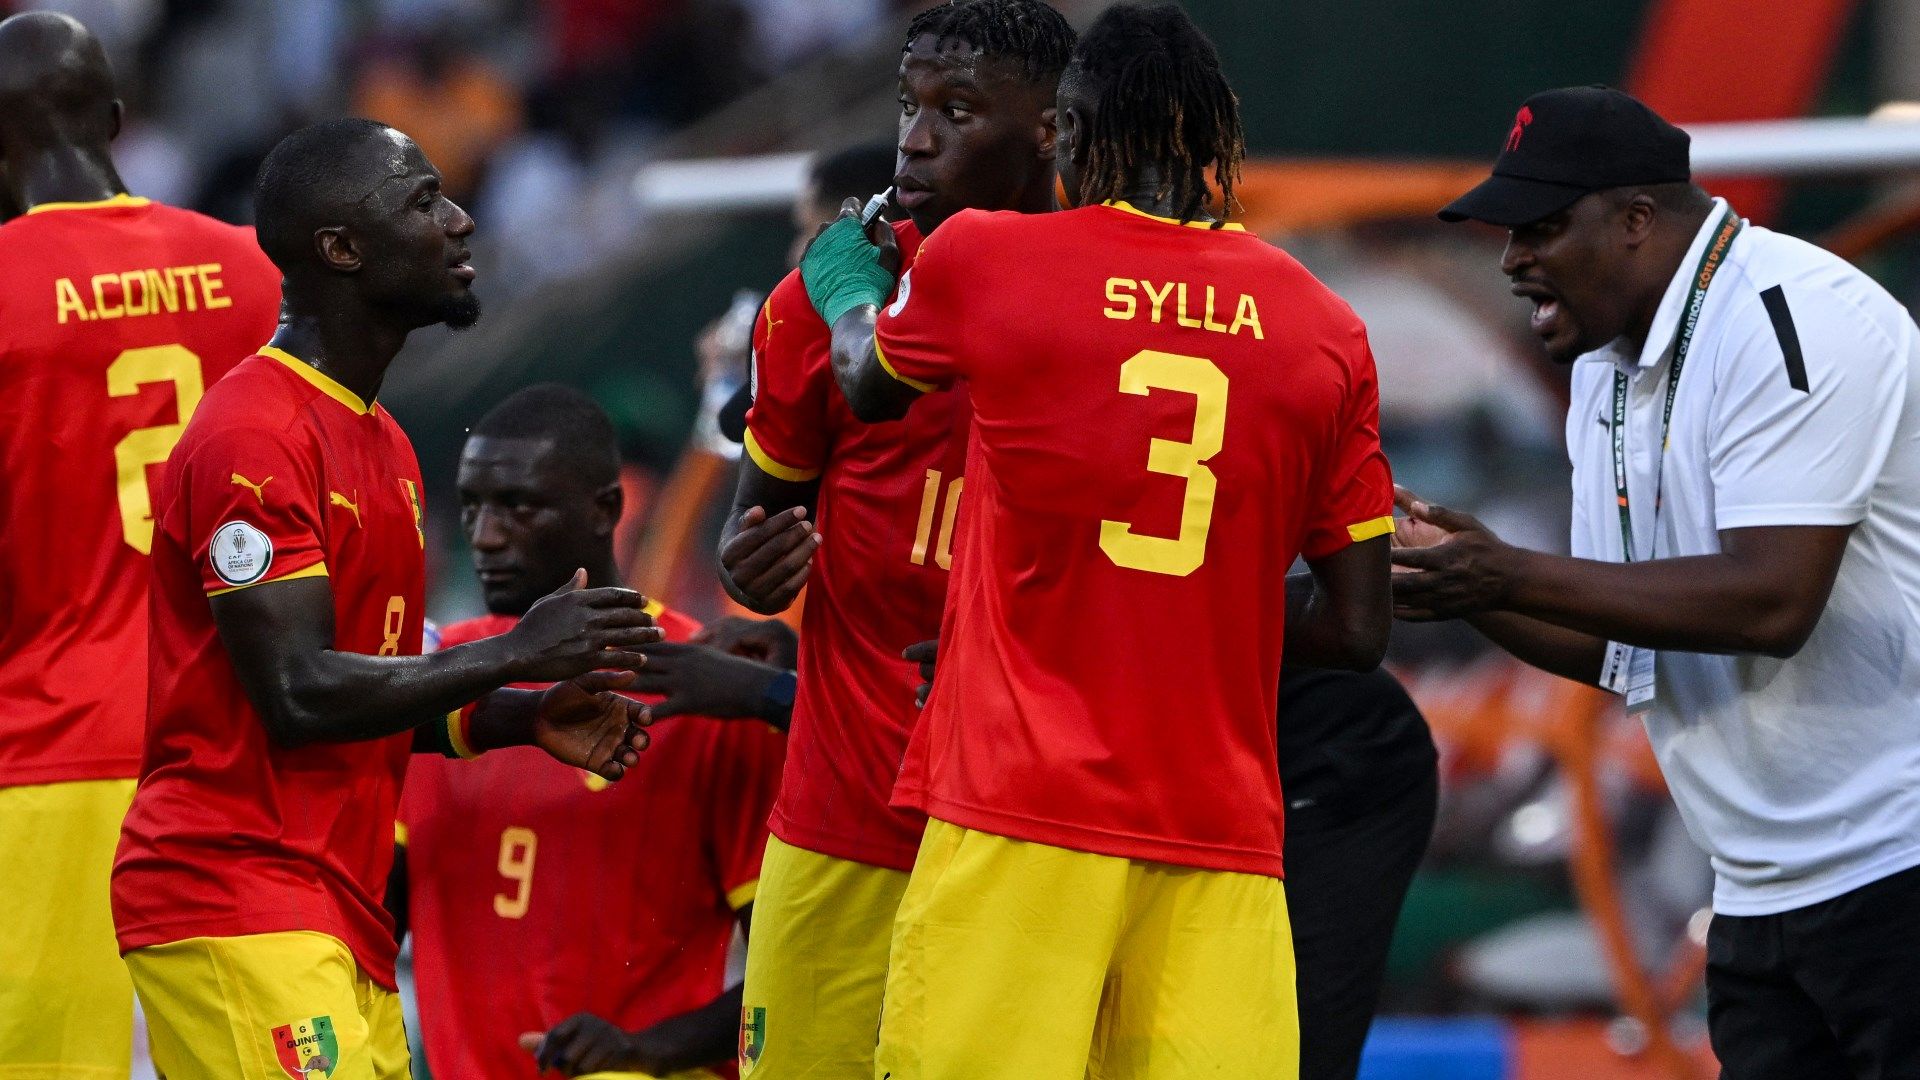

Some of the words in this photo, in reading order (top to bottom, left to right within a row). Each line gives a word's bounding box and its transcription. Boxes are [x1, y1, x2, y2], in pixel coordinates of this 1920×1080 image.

[55, 263, 232, 324] A.CONTE
[1103, 277, 1264, 340] SYLLA
[1673, 356, 1684, 378] CUP
[1679, 339, 1689, 355] OF
[1684, 288, 1705, 338] NATIONS
[1616, 382, 1626, 421] AFRICA
[106, 344, 204, 555] 2
[1099, 349, 1229, 576] 3
[378, 595, 405, 656] 8
[493, 826, 538, 919] 9
[279, 1031, 284, 1039] F
[299, 1025, 306, 1033] G
[320, 1021, 325, 1029] F
[287, 1033, 324, 1049] GUINEE
